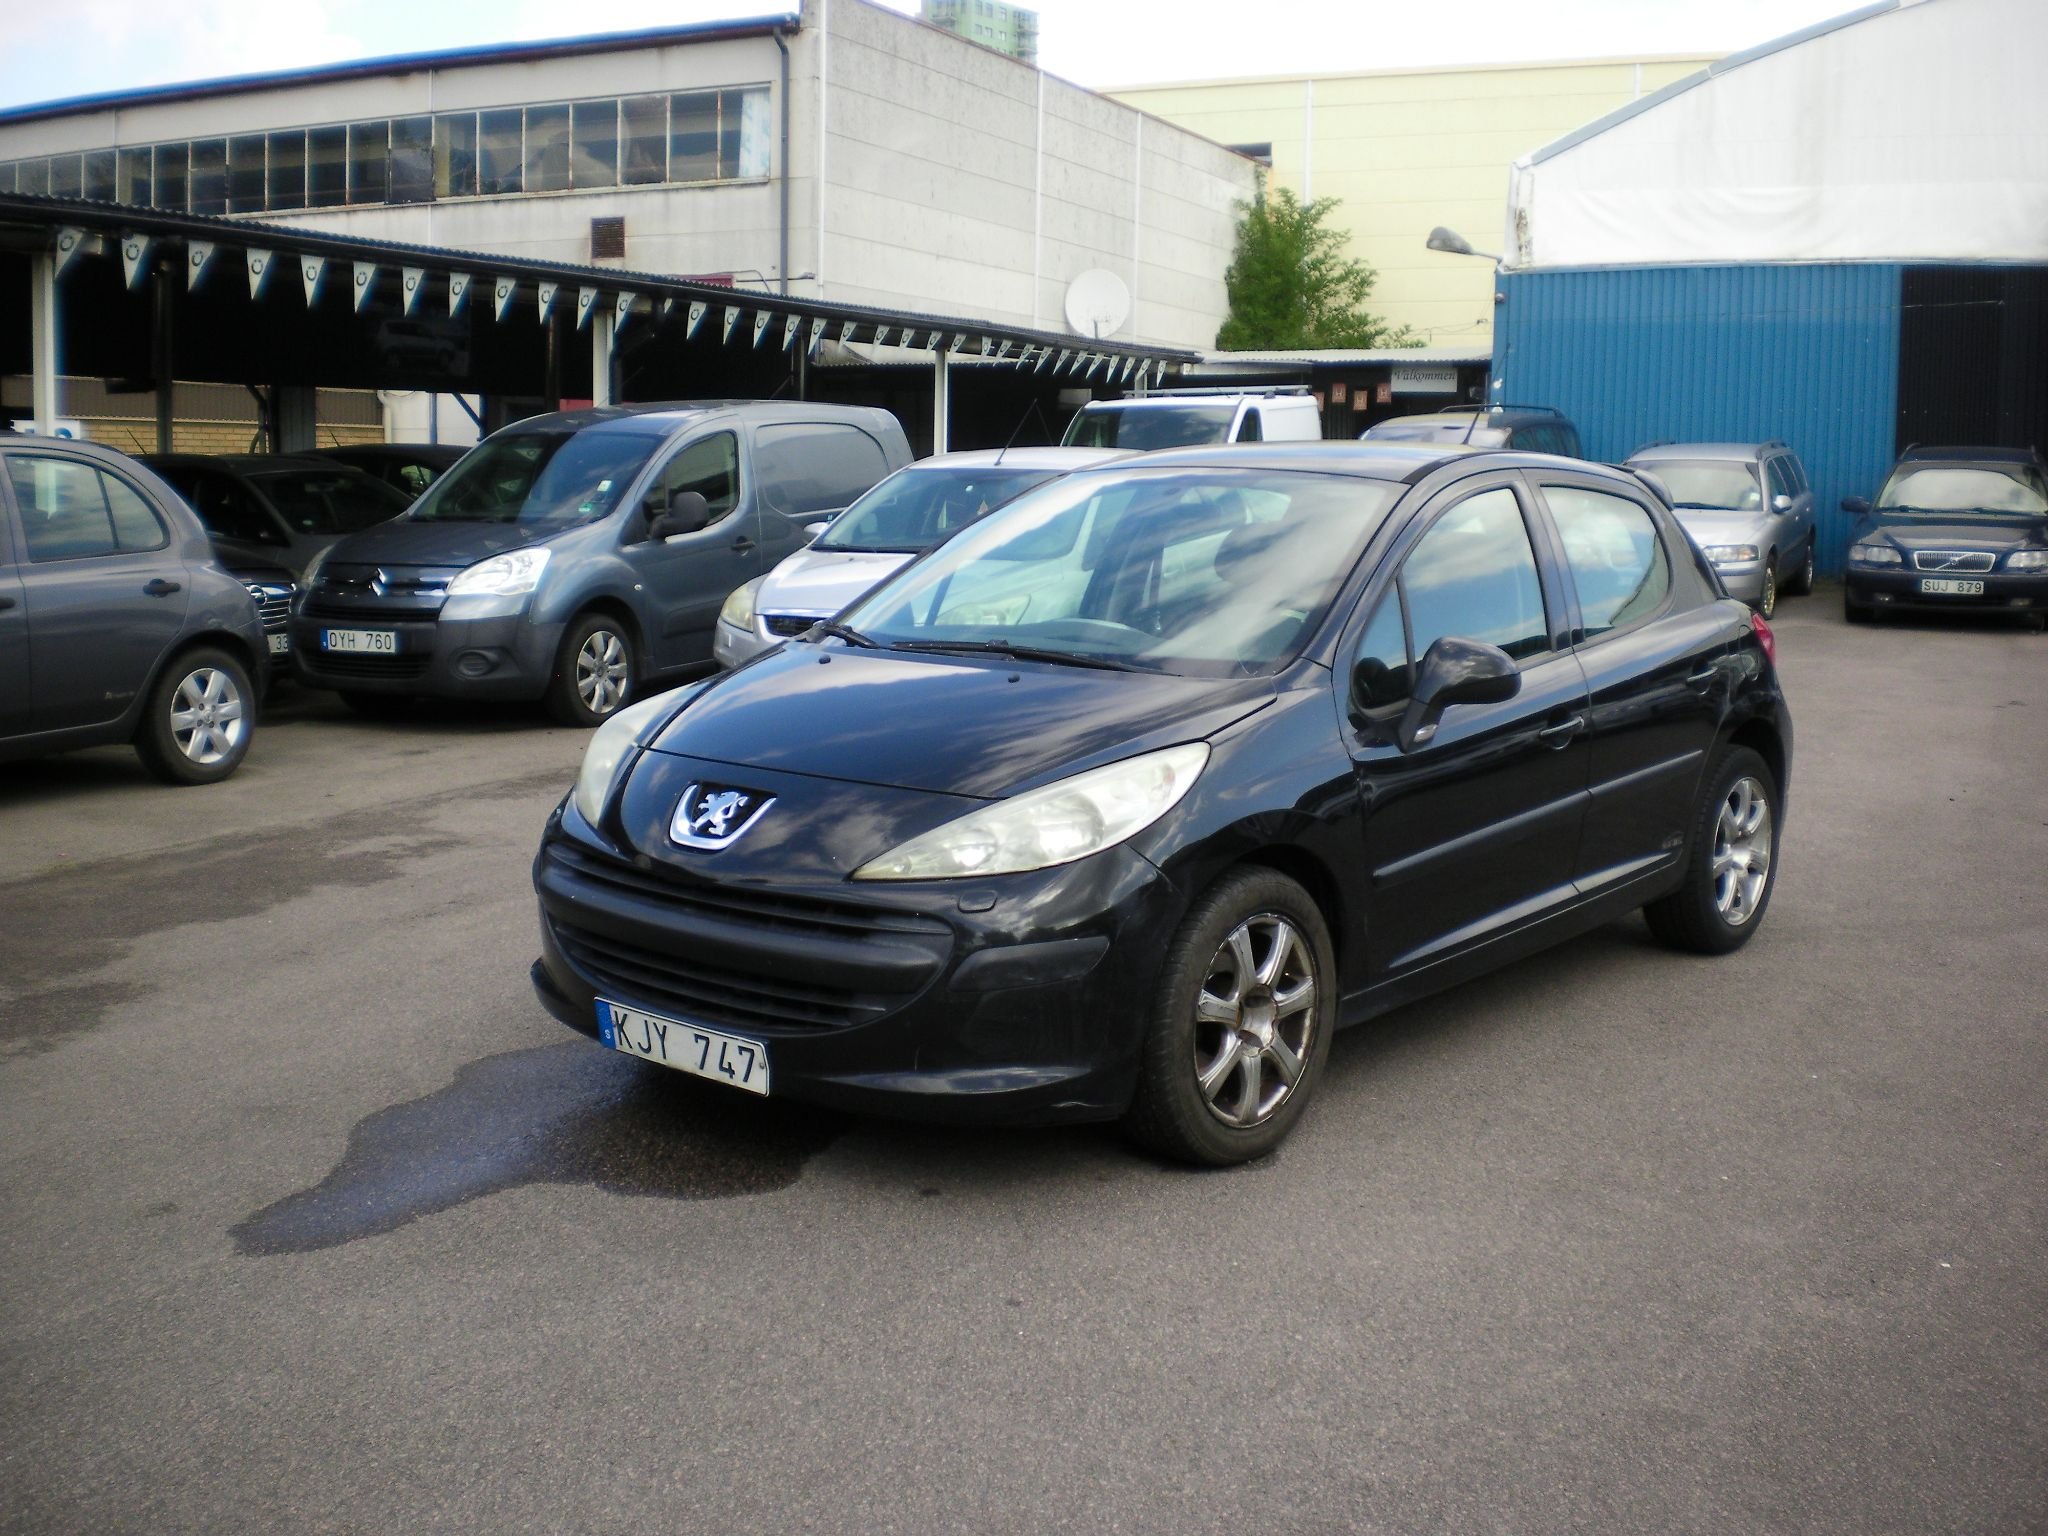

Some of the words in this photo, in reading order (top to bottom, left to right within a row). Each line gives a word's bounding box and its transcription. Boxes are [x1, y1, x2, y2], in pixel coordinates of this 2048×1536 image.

[1924, 580, 1948, 592] SUJ
[1957, 582, 1982, 593] 879
[329, 631, 355, 648] OYH
[366, 633, 392, 650] 760
[614, 1010, 667, 1060] KJY
[694, 1033, 755, 1083] 747
